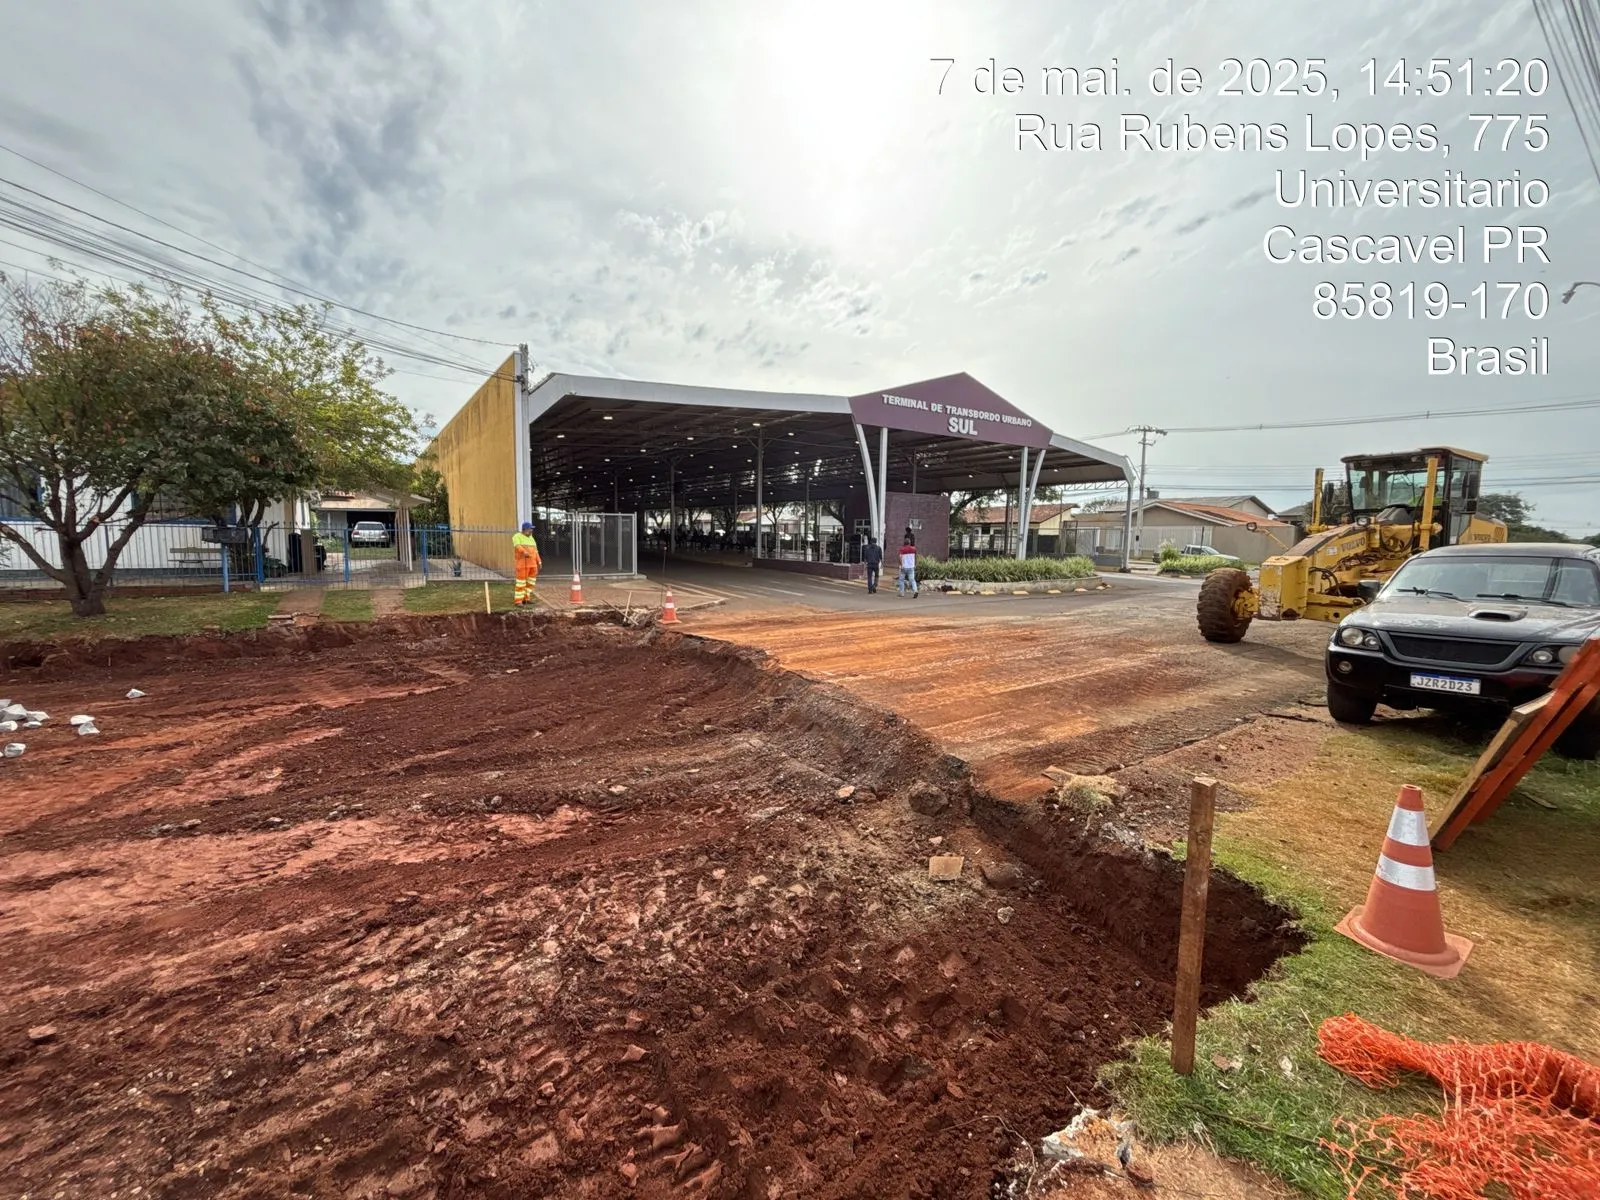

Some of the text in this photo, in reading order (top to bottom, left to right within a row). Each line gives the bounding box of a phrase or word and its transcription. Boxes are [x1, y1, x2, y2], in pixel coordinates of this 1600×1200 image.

[882, 394, 1032, 428] TERMINAL DE TRANSBORDO URBANO
[948, 416, 978, 436] SUL
[1416, 677, 1473, 692] JZR2D23
